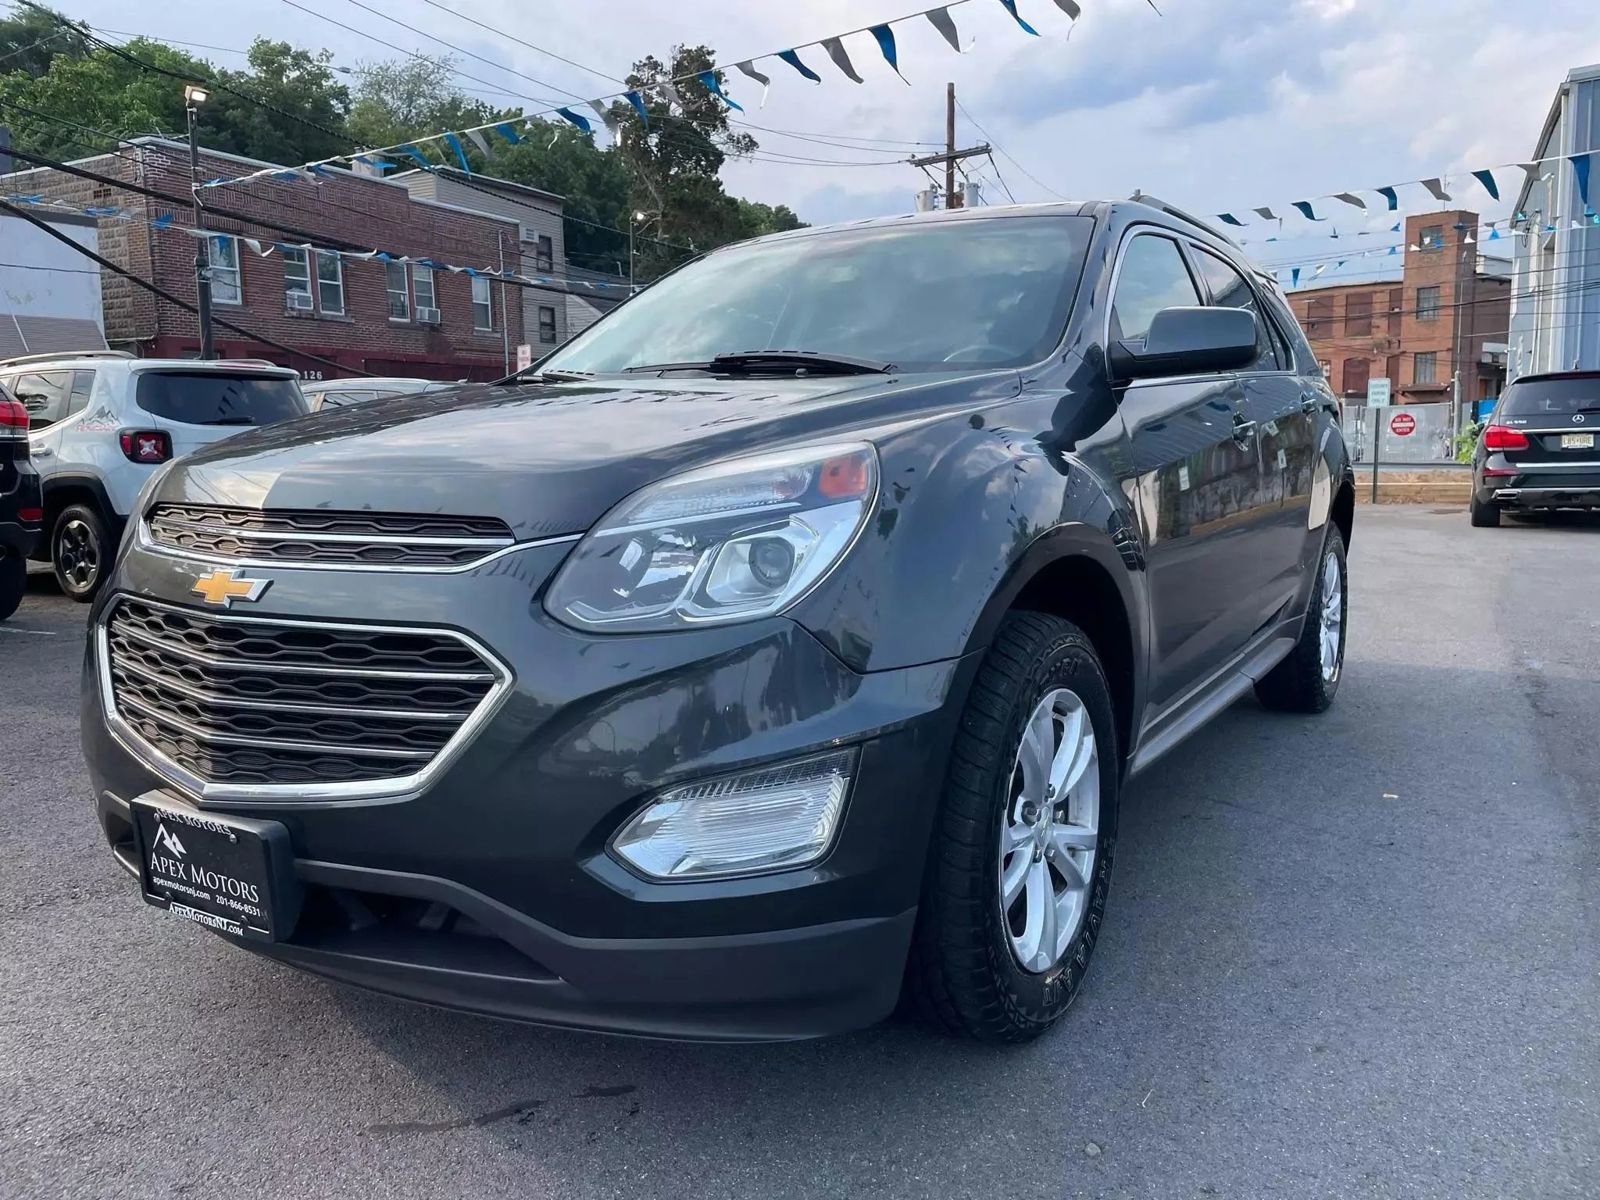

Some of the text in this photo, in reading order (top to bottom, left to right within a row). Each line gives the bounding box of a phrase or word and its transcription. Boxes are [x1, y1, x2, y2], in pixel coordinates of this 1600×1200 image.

[304, 370, 323, 380] 126
[156, 808, 233, 836] APEX MOTORS
[151, 851, 260, 903] APEX MOTORS
[153, 876, 261, 917] apexmotorsnj.com 201-866-8531
